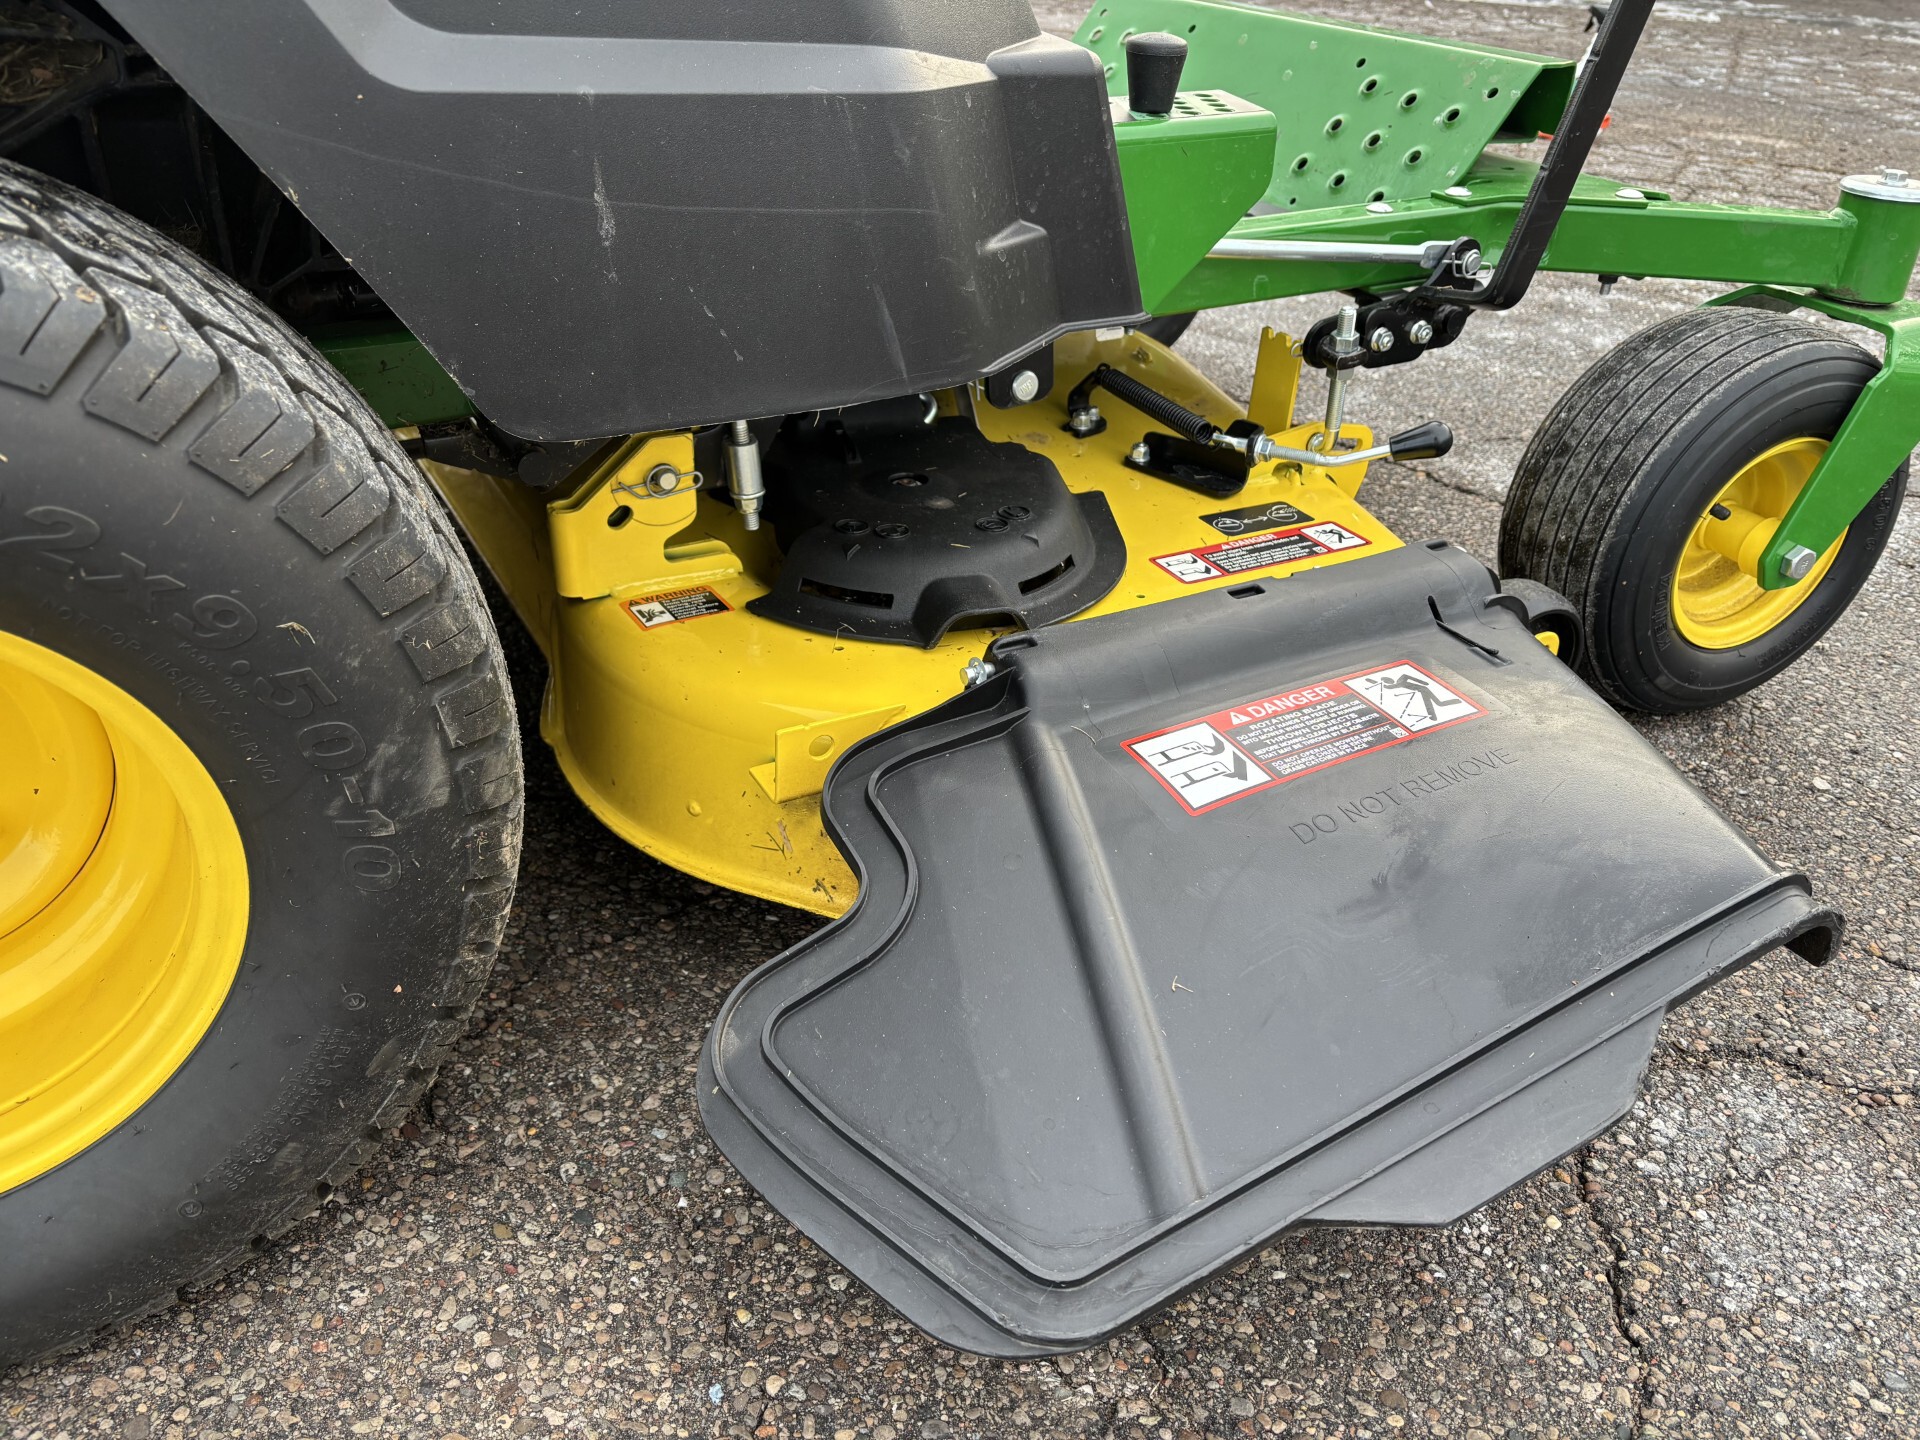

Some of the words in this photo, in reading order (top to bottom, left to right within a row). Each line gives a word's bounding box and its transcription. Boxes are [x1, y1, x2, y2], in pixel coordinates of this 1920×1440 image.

[1229, 533, 1277, 548] DANGER
[641, 586, 708, 603] WARNING
[144, 652, 231, 717] HIGHWAY
[1246, 684, 1336, 719] DANGER
[1240, 736, 1260, 745] INTO
[1257, 728, 1286, 740] MOWER
[1283, 722, 1306, 732] WHEN
[1303, 714, 1330, 725] ENGINE
[1246, 729, 1263, 737] NOT
[1261, 725, 1277, 733] PUT
[1275, 717, 1301, 728] HANDS
[1309, 709, 1328, 718] FEET
[1326, 702, 1351, 713] UNDER
[1248, 710, 1302, 731] ROTATING
[1301, 699, 1338, 714] BLADE
[1262, 726, 1311, 746] THROWN
[1309, 711, 1359, 731] OBJECTS
[1252, 743, 1280, 755] BEFORE
[1305, 728, 1328, 738] CLEAR
[1325, 723, 1345, 732] AREA
[1350, 712, 1380, 724] OBJECTS
[1258, 750, 1279, 760] THAT
[1275, 745, 1294, 754] MAY
[1301, 733, 1332, 746] THROWN
[1270, 759, 1285, 767] DO
[1282, 754, 1301, 763] NOT
[1298, 743, 1334, 758] OPERATE
[1332, 734, 1361, 747] MOWER
[1358, 724, 1393, 738] WITHOUT
[1275, 754, 1317, 771] DISCHARGE
[1314, 746, 1340, 757] CHUTE
[1348, 735, 1375, 747] ENTIRE
[1279, 762, 1307, 775] GRASS
[1305, 751, 1340, 766] CATCHER
[1289, 811, 1338, 846] DO
[1338, 786, 1401, 823] NOT
[1399, 747, 1519, 798] REMOVE
